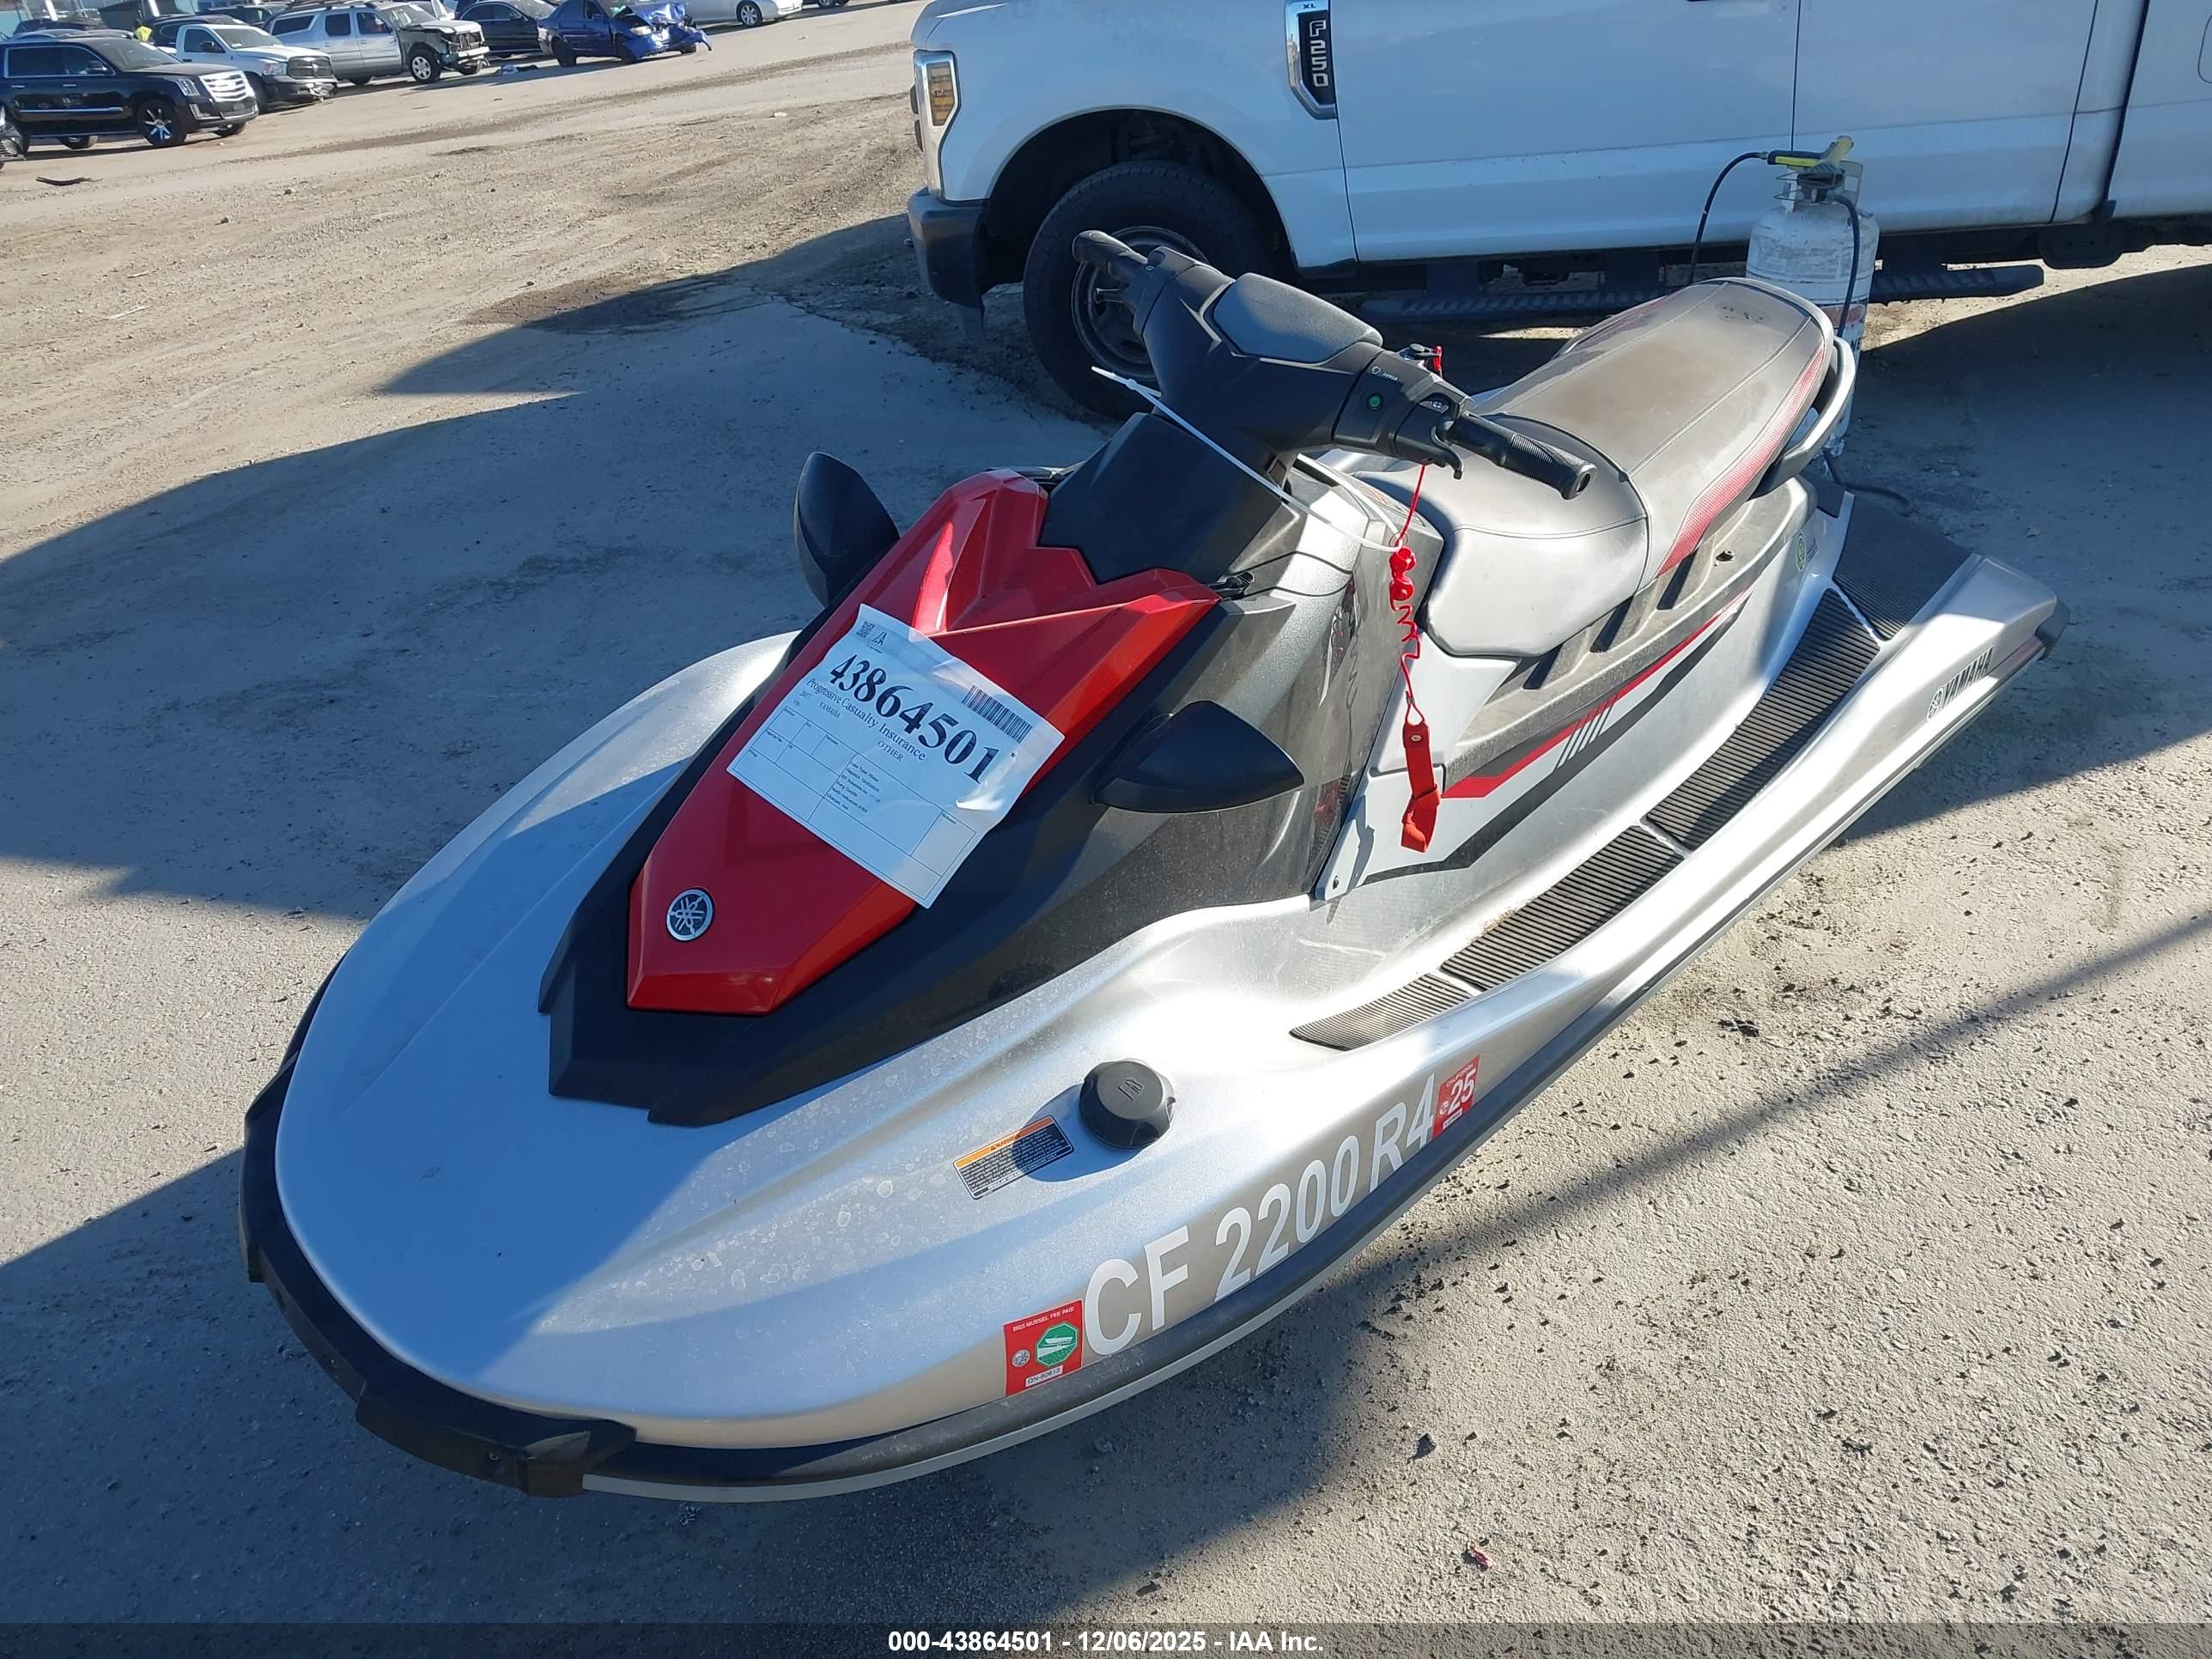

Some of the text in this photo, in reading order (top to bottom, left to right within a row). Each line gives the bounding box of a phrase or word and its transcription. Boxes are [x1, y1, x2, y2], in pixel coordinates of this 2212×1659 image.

[1309, 20, 1329, 87] F250
[1942, 645, 1994, 709] YAMAHA
[805, 678, 926, 761] Progressive Casualty Insurance
[817, 702, 841, 720] YAMAHA
[877, 740, 904, 763] OTHER
[830, 654, 1000, 785] 43864501
[1448, 1066, 1476, 1115] 25
[1085, 1225, 1189, 1356] CF
[1214, 1134, 1360, 1303] 2200
[1370, 1073, 1435, 1194] R4
[1026, 1316, 1048, 1328] MUSSEL
[1061, 1306, 1075, 1315] PAID
